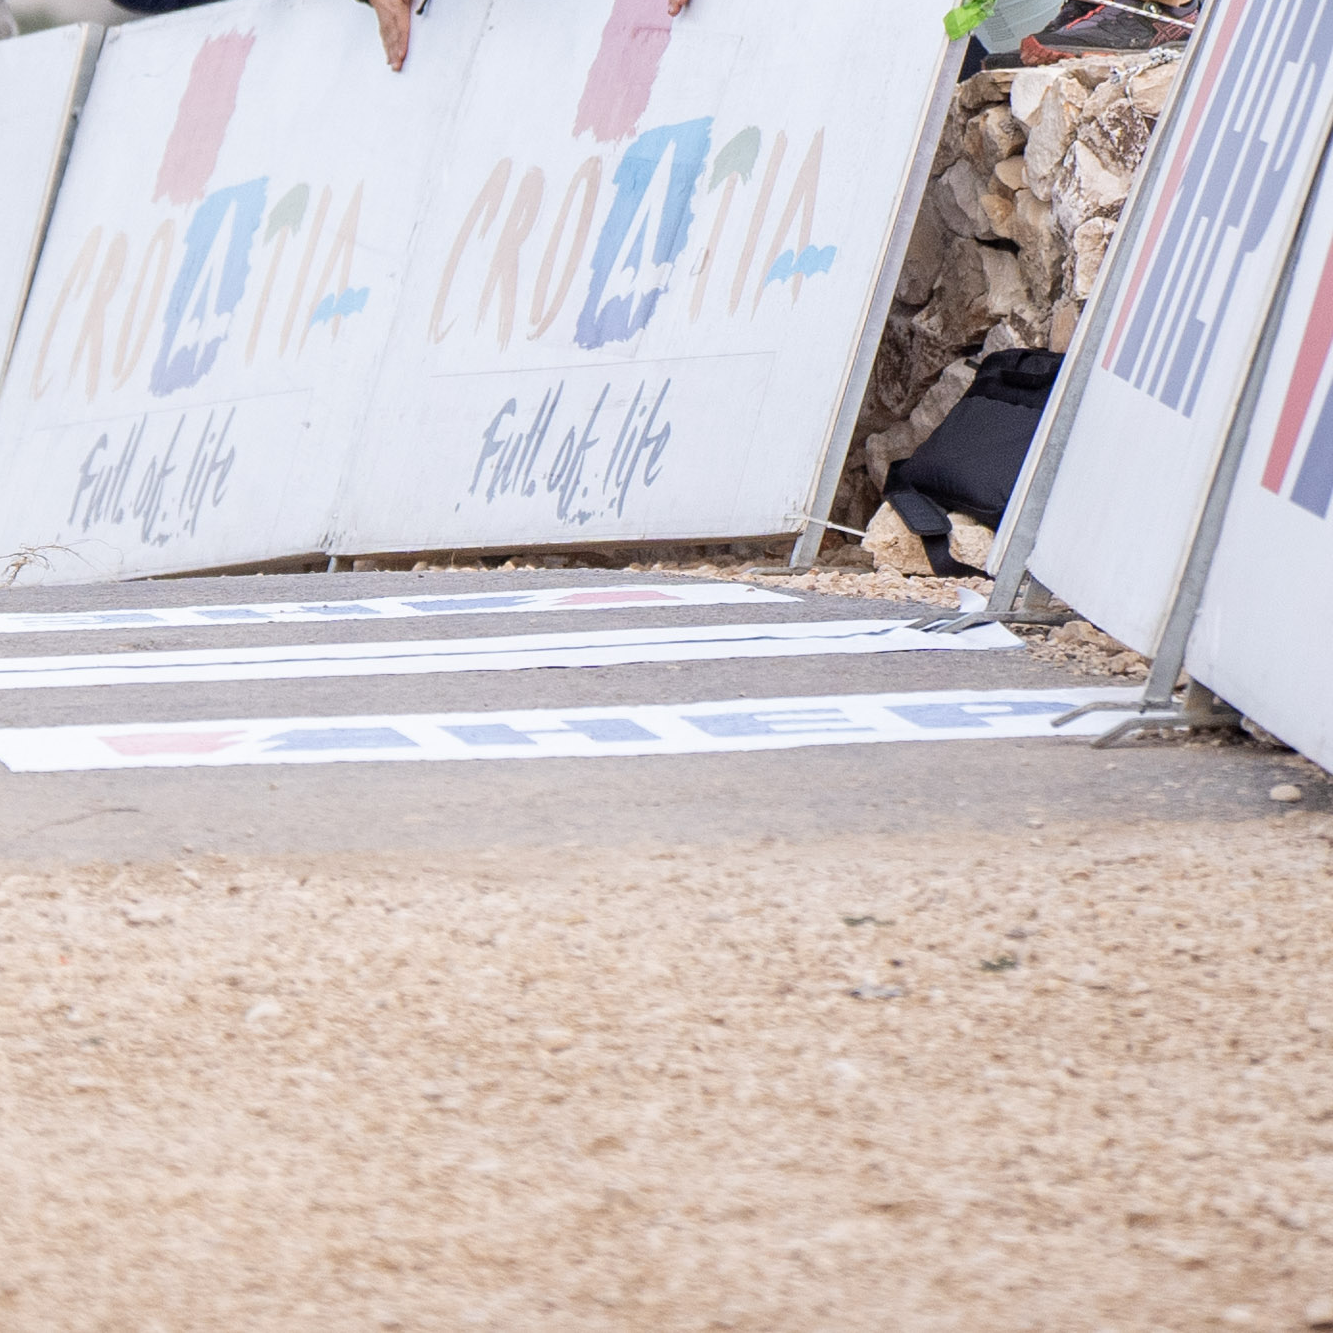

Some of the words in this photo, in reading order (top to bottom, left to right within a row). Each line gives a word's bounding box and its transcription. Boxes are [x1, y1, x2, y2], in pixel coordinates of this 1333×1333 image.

[31, 176, 370, 403] CROATIA
[427, 116, 836, 352] CROATIA
[68, 411, 146, 533] Full
[130, 413, 186, 543] of
[178, 406, 237, 537] life
[467, 379, 565, 504] Full
[546, 383, 609, 522] of
[601, 377, 672, 519] life
